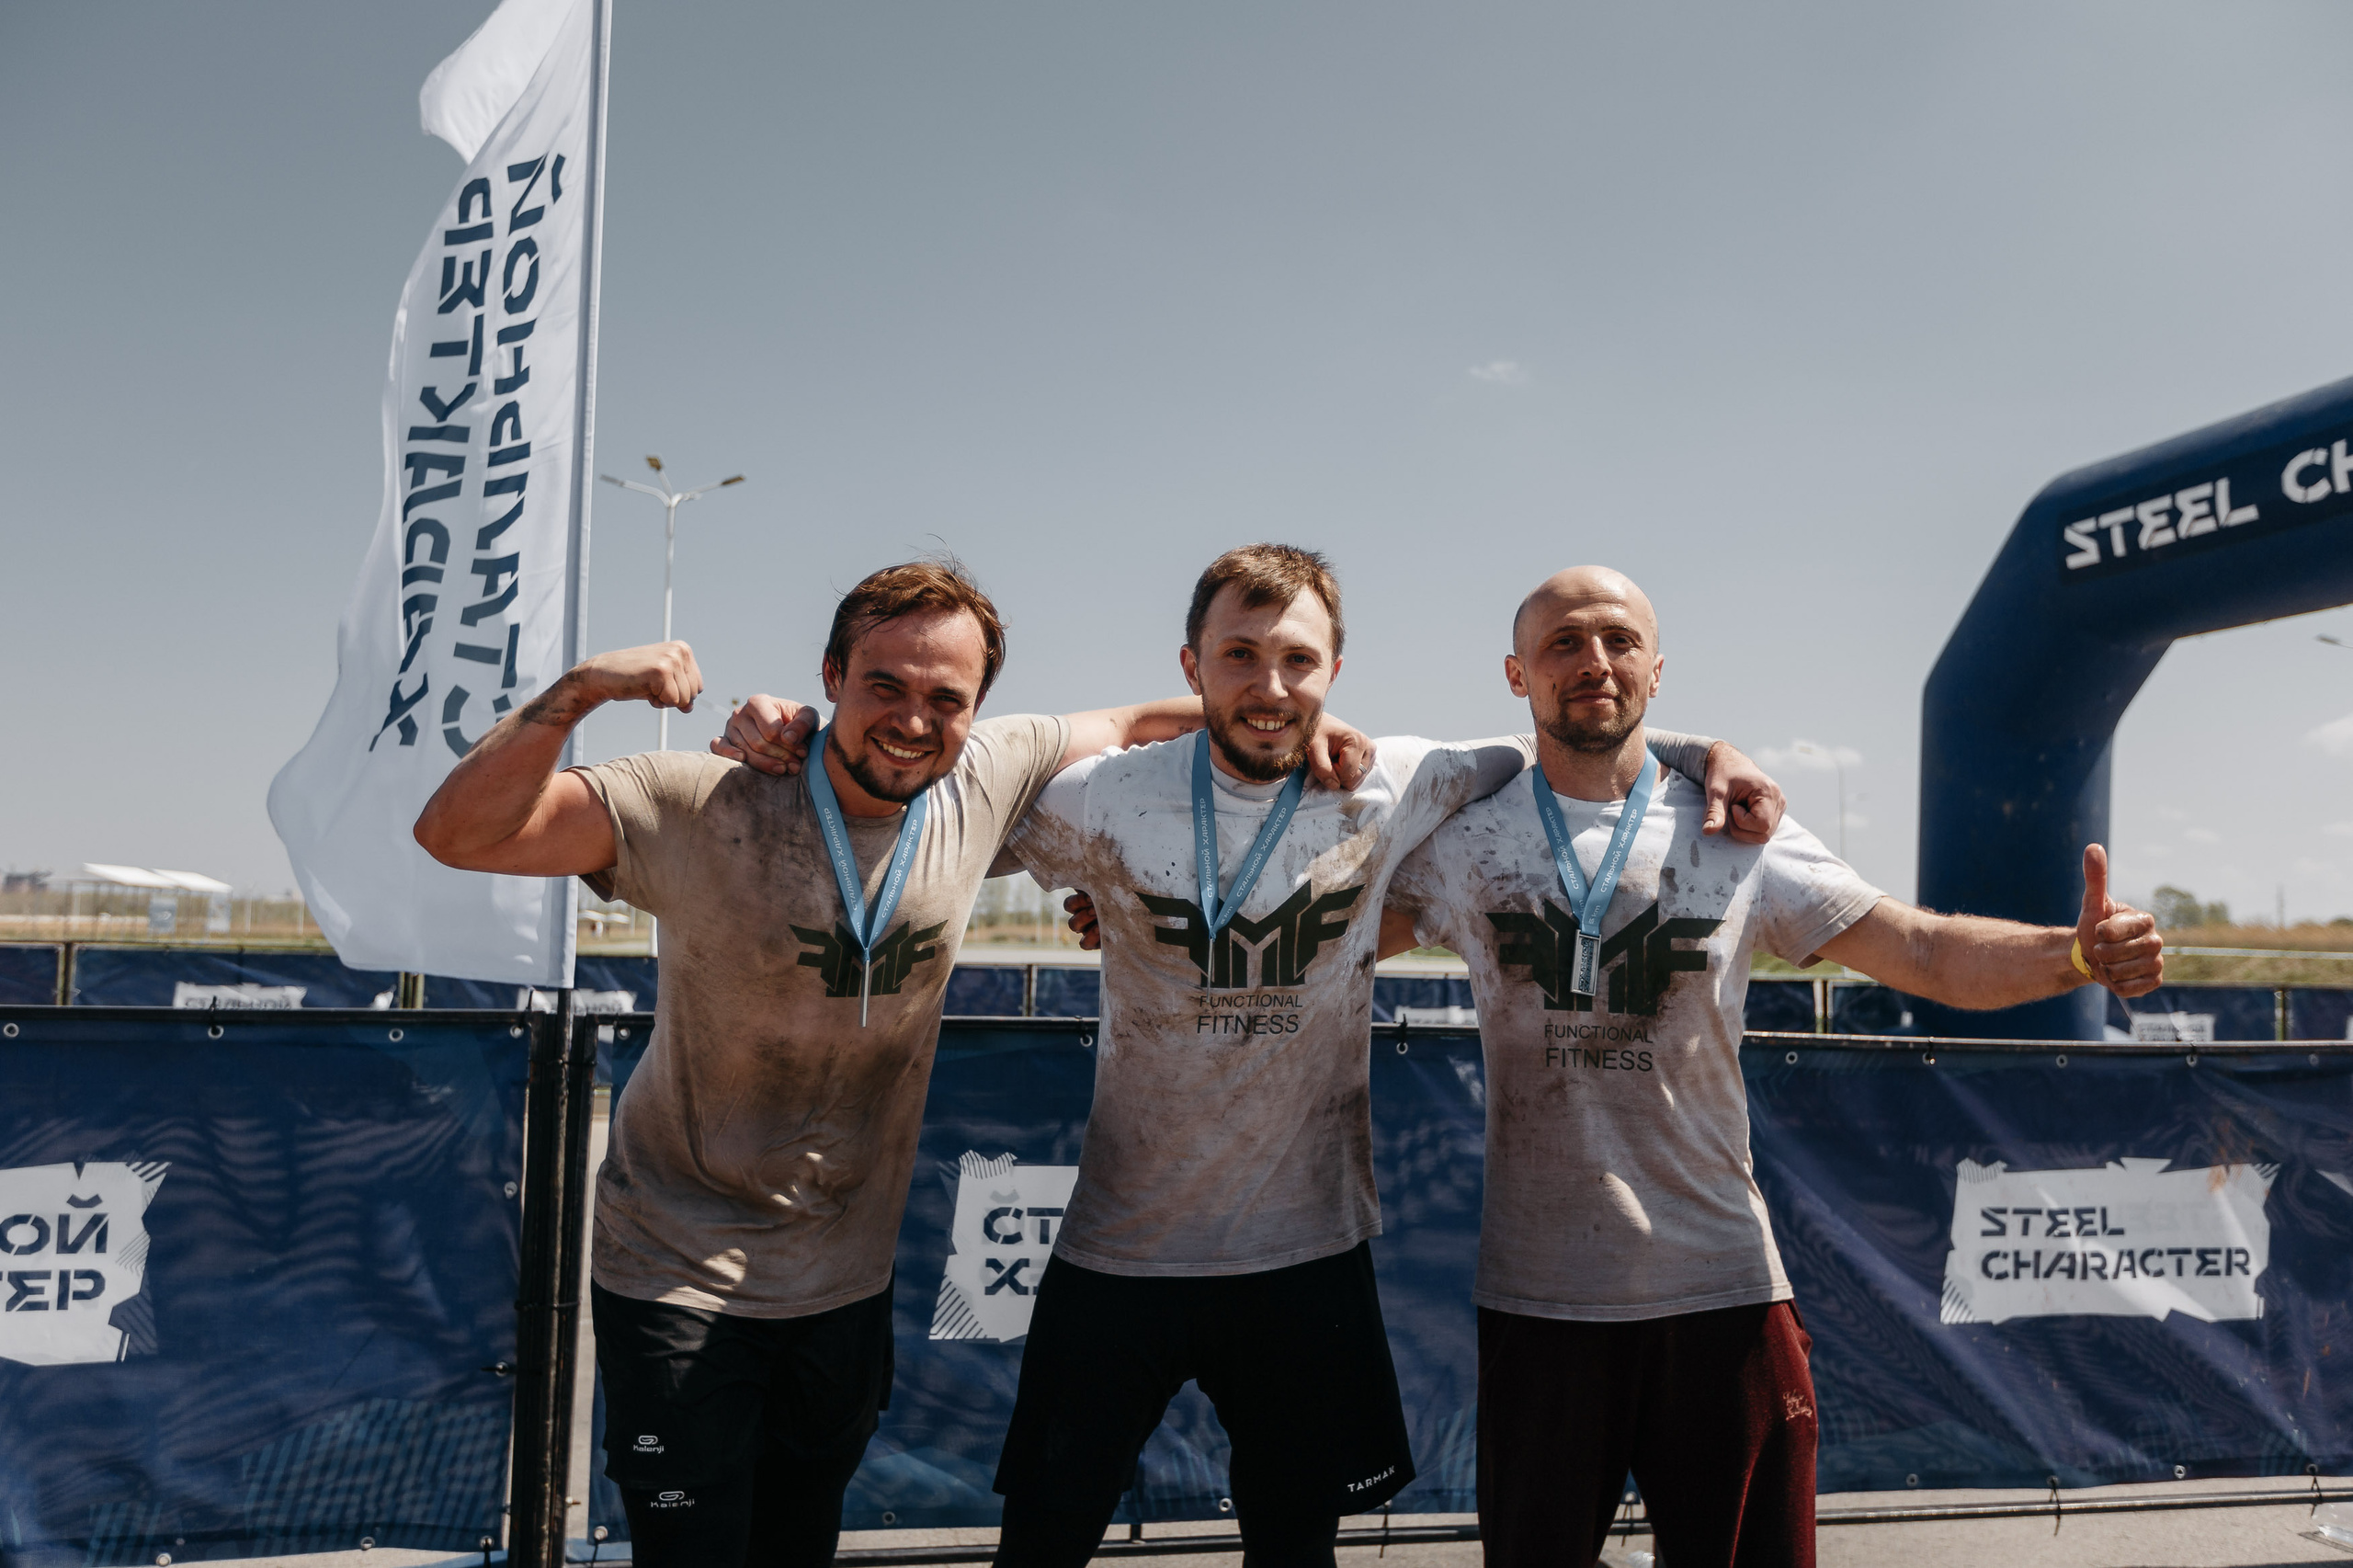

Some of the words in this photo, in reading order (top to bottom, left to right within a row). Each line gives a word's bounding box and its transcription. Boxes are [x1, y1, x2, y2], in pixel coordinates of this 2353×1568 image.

[2063, 476, 2259, 571] STEEL
[824, 808, 845, 857] ХАРАКТЕР
[1199, 798, 1210, 846] ХАРАКТЕР
[881, 869, 903, 918] СТАЛЬНОЙ
[899, 819, 917, 867] ХАРАКТЕР
[1201, 848, 1213, 898] СТАЛЬНОЙ
[1236, 852, 1263, 898] СТАЛЬНОЙ
[1260, 807, 1288, 852] ХАРАКТЕР
[1600, 850, 1622, 893] СТАЛЬНОЙ
[1618, 809, 1638, 848] ХАРАКТЕР
[838, 859, 858, 911] СТАЛЬНОЙ
[1199, 994, 1303, 1008] FUNCTIONAL
[1197, 1014, 1299, 1035] FITNESS
[1544, 1024, 1654, 1044] FUNCTIONAL
[1545, 1048, 1654, 1073] FITNESS
[1980, 1206, 2125, 1238] STEEL
[984, 1258, 1039, 1295] Х
[1981, 1246, 2251, 1280] CHARACTER
[0, 1268, 106, 1312] ЕР
[1347, 1465, 1395, 1493] TARMAK
